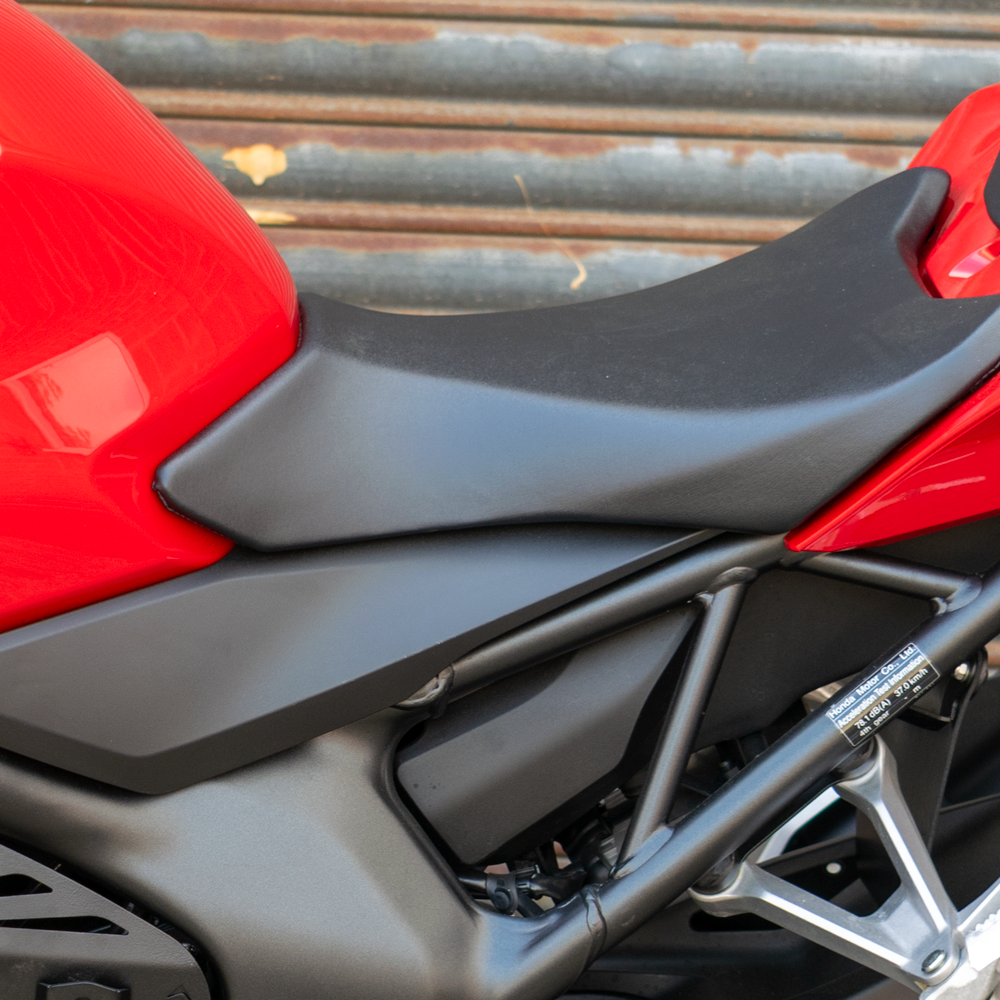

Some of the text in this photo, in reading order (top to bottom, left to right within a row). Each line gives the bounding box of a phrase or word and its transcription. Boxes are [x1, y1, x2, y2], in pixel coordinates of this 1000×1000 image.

[828, 696, 856, 718] Honda
[855, 675, 881, 696] Motor
[899, 646, 916, 660] Ltd.
[837, 694, 877, 728] Acceleration
[873, 682, 892, 697] Test
[887, 654, 925, 686] Information
[859, 724, 872, 737] 4th
[873, 710, 891, 727] gear
[912, 684, 922, 694] m
[893, 682, 910, 698] 37.0
[909, 667, 929, 685] km/h
